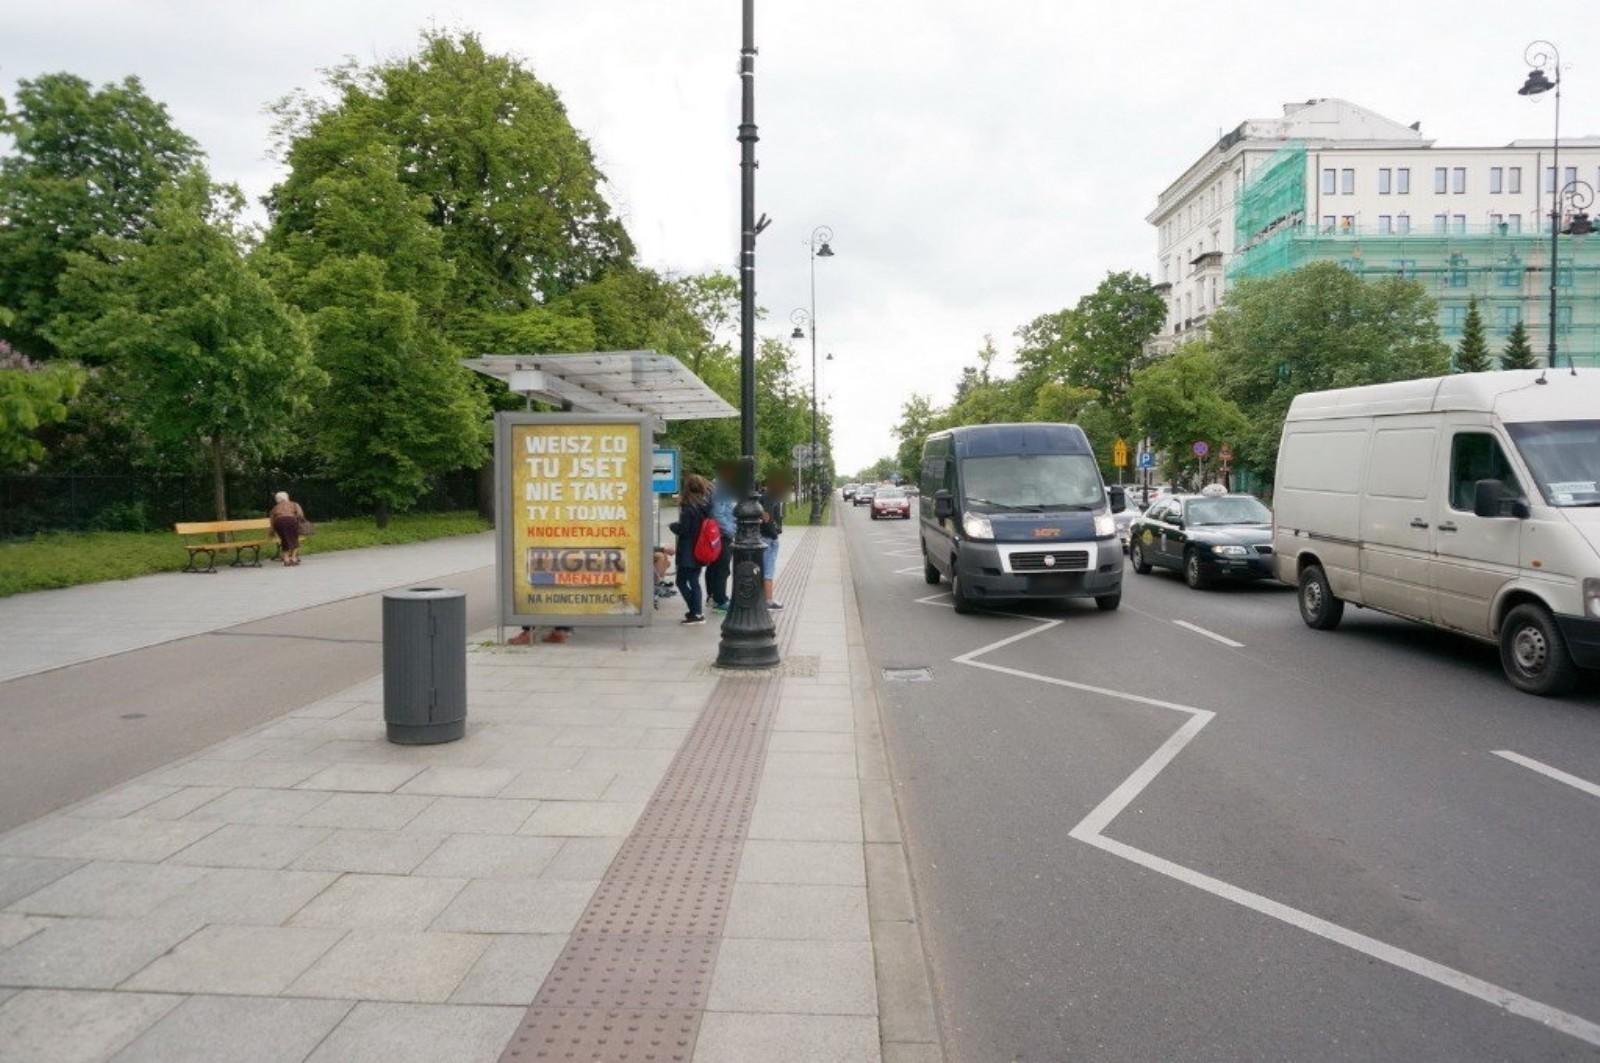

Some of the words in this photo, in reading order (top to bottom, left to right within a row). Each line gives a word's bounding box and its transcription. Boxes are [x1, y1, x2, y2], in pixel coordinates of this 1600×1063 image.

[526, 436, 592, 454] WEISZ
[600, 436, 627, 453] CO
[526, 457, 560, 478] TU
[568, 457, 627, 478] JSET
[526, 482, 562, 501] NIE
[569, 481, 628, 501] TAK?
[526, 506, 549, 520] TY
[555, 506, 561, 520] I
[566, 506, 627, 520] TOJWA
[530, 548, 625, 572] TIGER
[558, 572, 618, 584] MENTAL
[527, 594, 543, 604] NA
